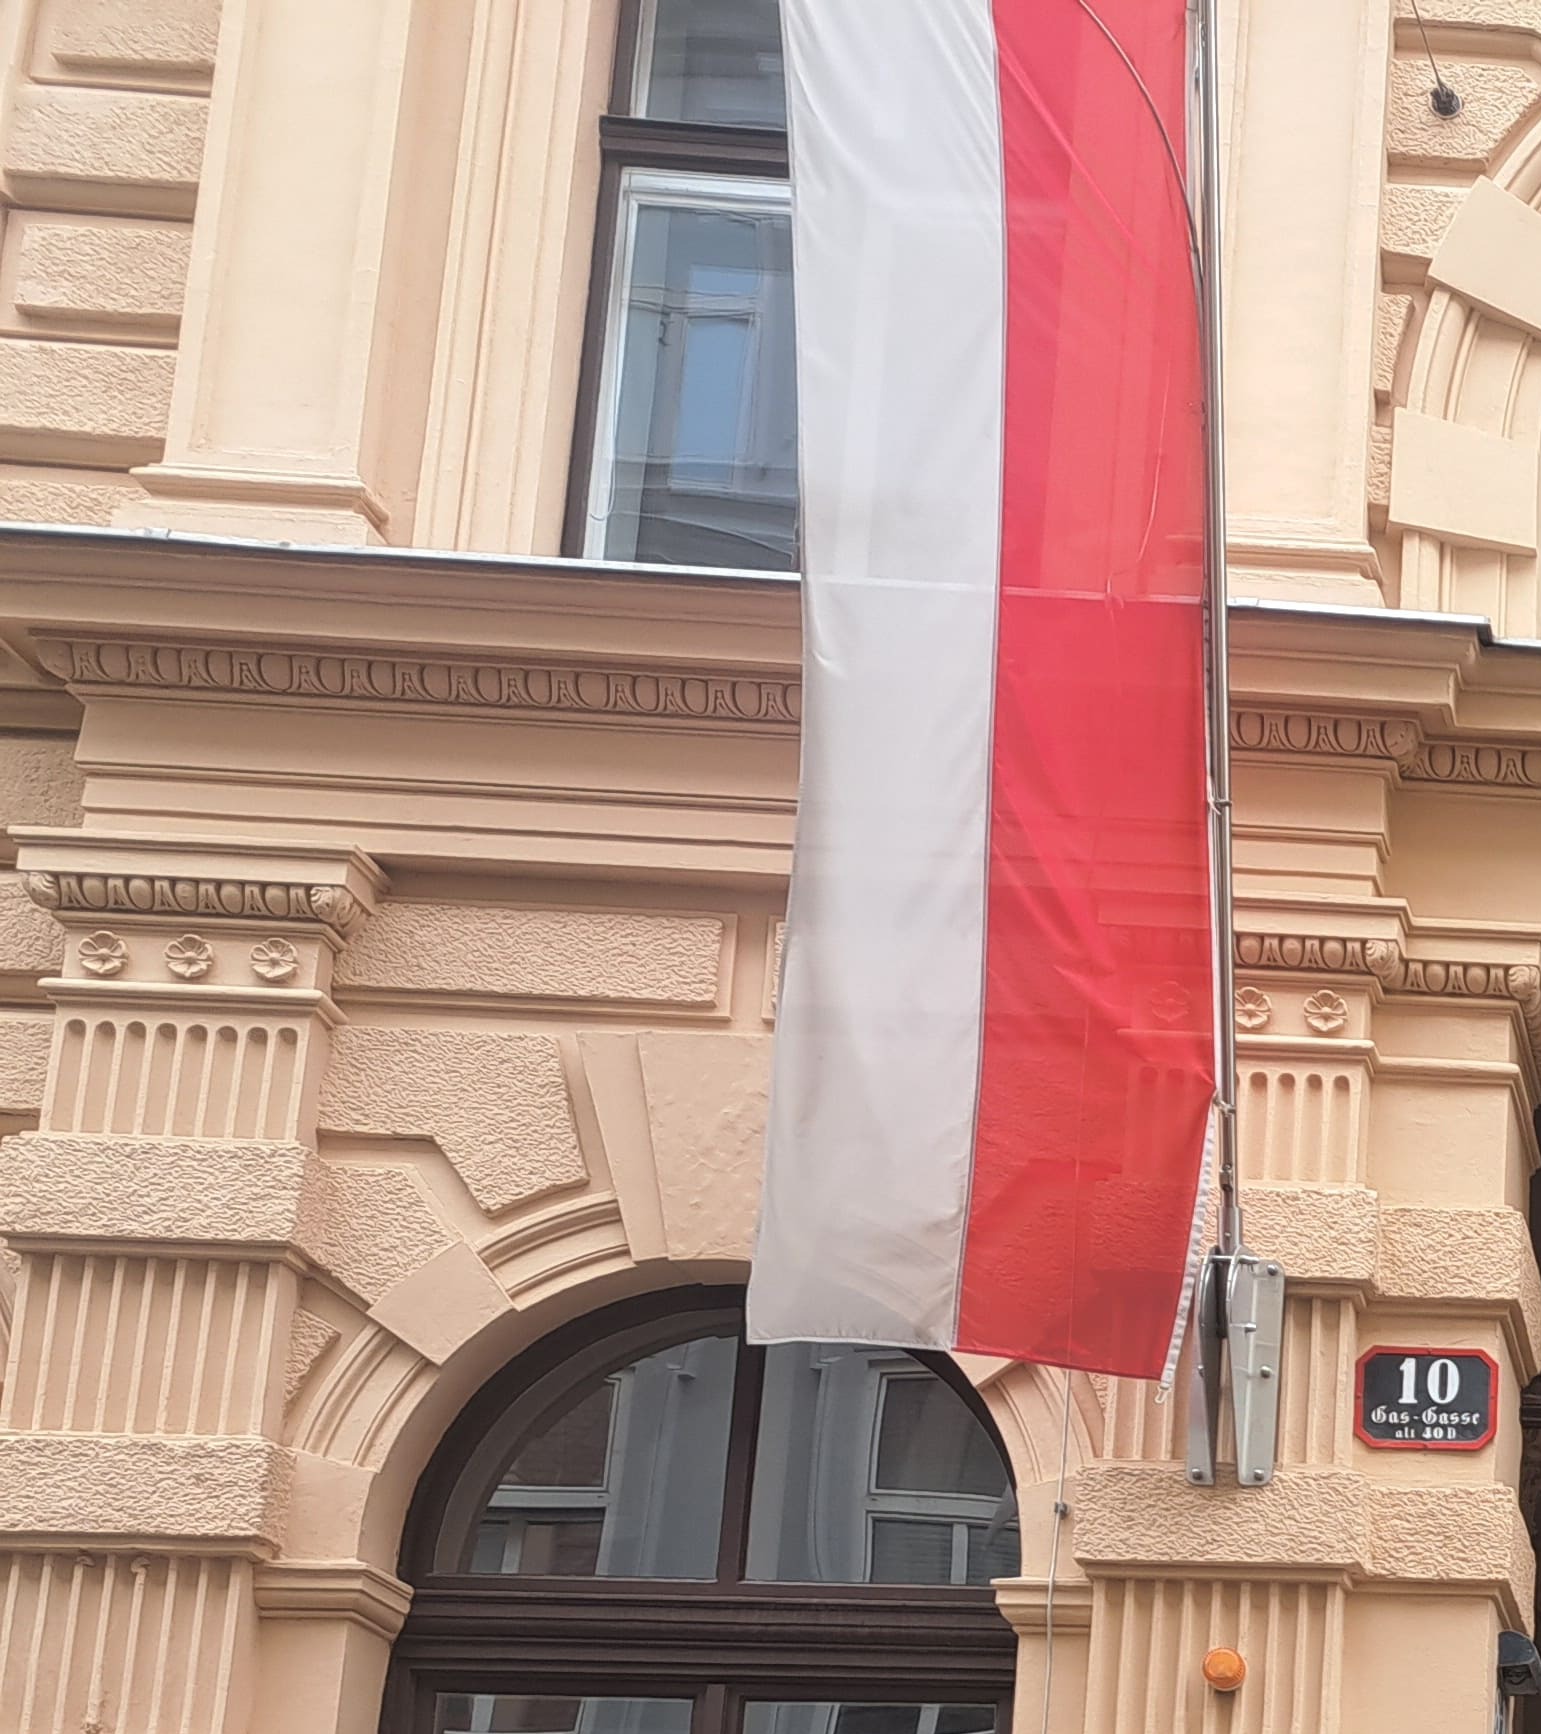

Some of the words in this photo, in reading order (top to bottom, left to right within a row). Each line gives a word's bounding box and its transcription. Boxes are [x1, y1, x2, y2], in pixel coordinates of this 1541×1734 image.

[1398, 1357, 1460, 1405] 10
[1371, 1405, 1480, 1425] Gas-Gasse
[1395, 1427, 1415, 1439] alt
